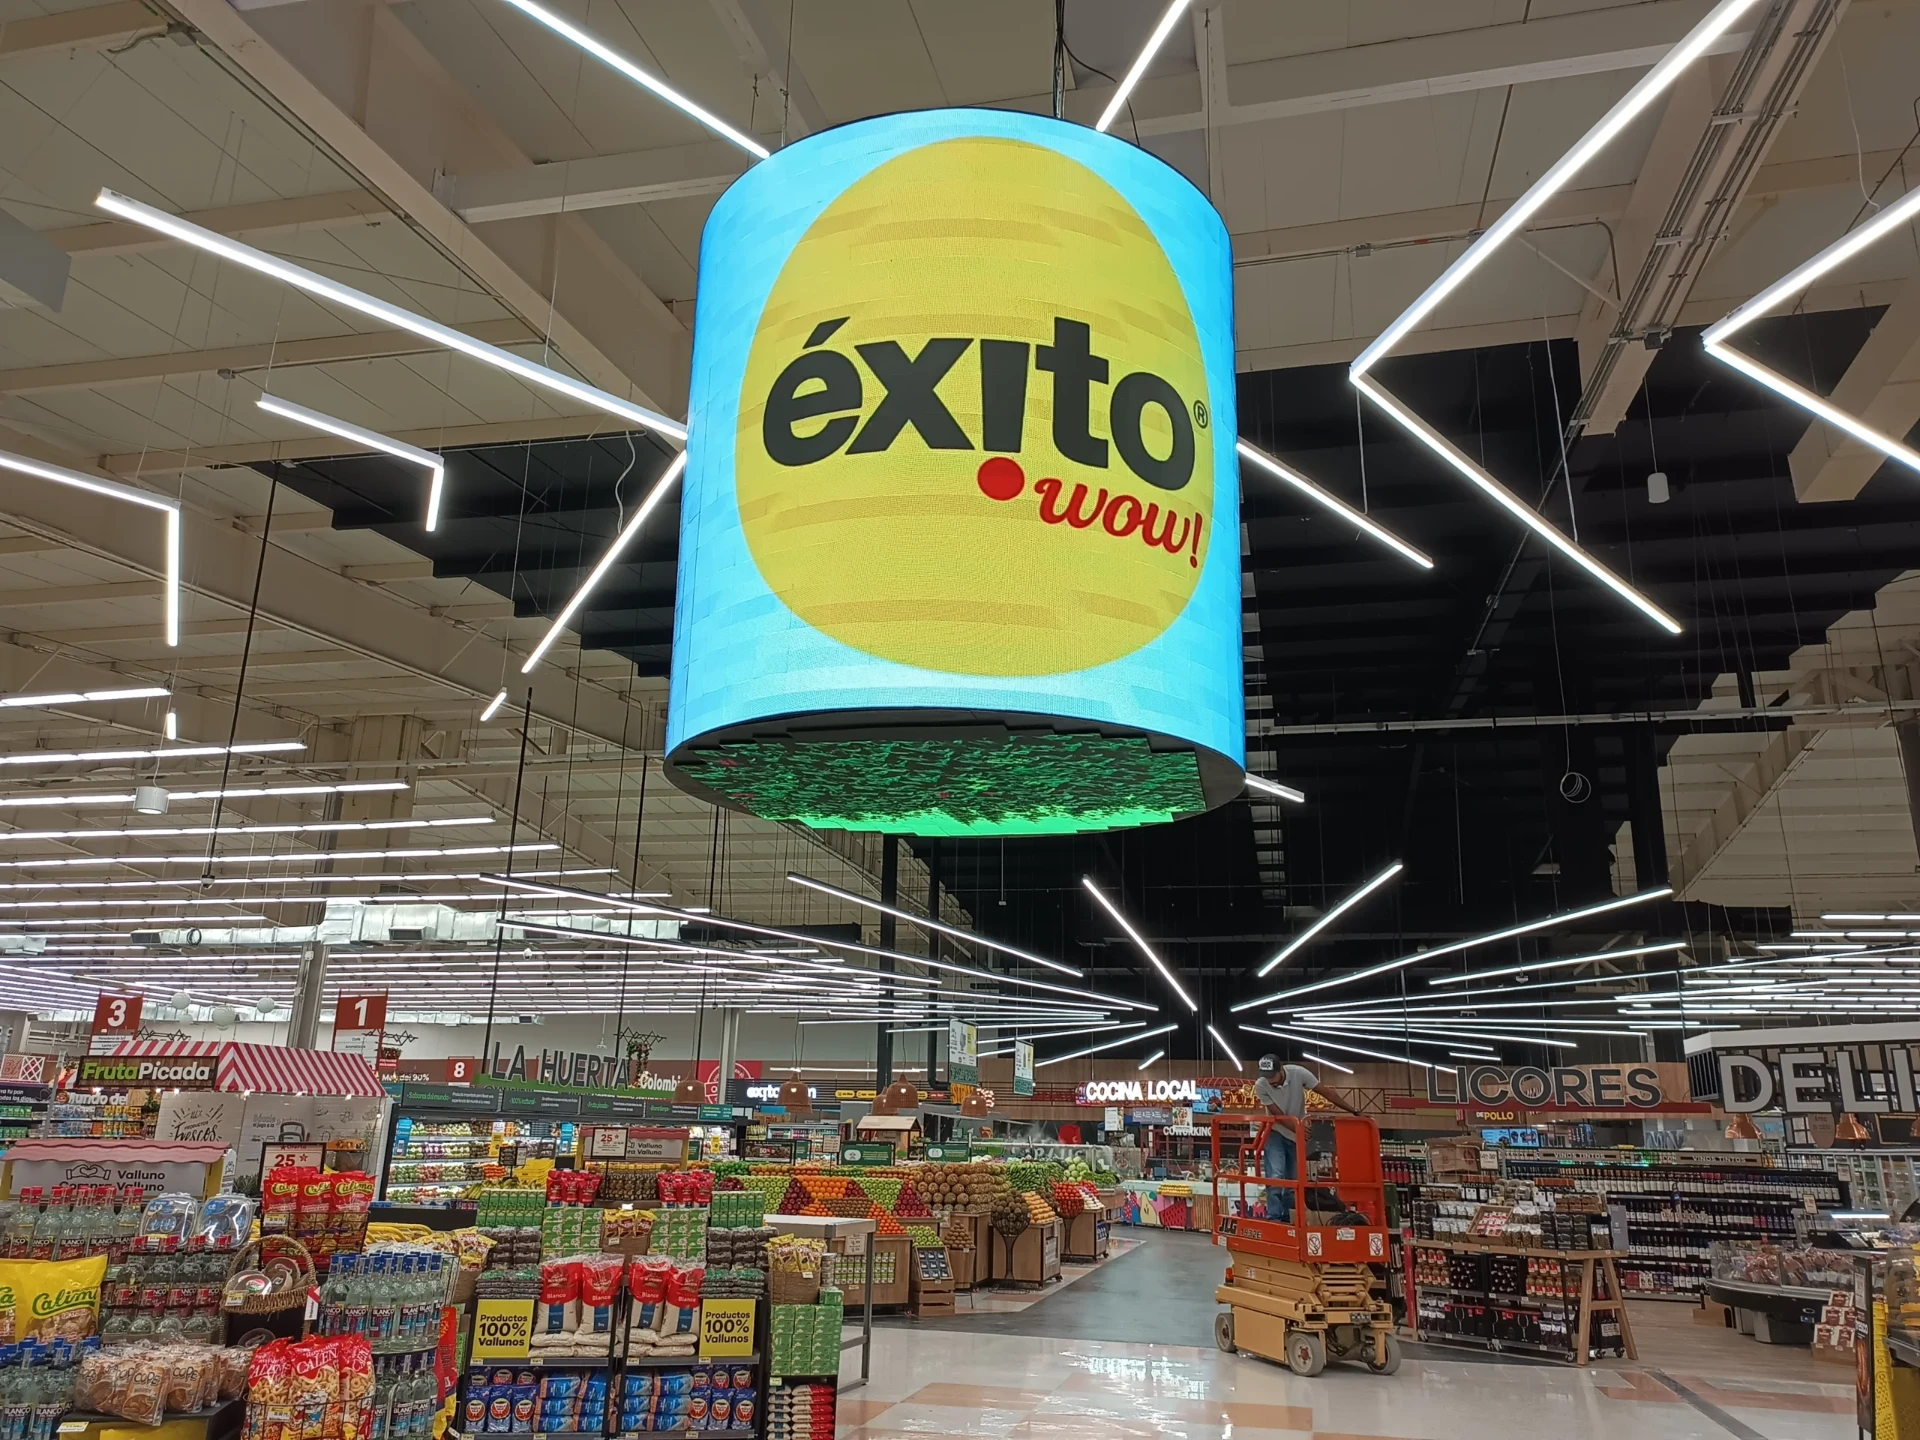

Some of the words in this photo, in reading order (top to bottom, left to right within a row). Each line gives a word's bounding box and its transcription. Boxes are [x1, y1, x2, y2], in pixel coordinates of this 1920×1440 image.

[762, 316, 1195, 500] éxito
[1033, 477, 1203, 568] wow!
[107, 999, 127, 1027] 3
[354, 998, 368, 1027] 1
[453, 1062, 466, 1078] 8
[490, 1041, 527, 1083] LA
[539, 1048, 631, 1091] HUERTA
[412, 1073, 429, 1081] 90%
[639, 1071, 682, 1092] Colombi
[1718, 1050, 1916, 1113] DELI
[1085, 1081, 1143, 1101] COCINA
[1147, 1080, 1202, 1101] LOCAL
[1425, 1065, 1661, 1108] LICORES
[1484, 1111, 1514, 1121] POLLO
[601, 1134, 613, 1142] 25
[274, 1153, 296, 1168] 25
[117, 1170, 166, 1180] Valluno
[116, 1182, 165, 1191] Valluno
[1218, 1217, 1239, 1235] JLG
[1240, 1228, 1262, 1239] 1932E
[641, 1291, 660, 1299] Blanco
[678, 1295, 698, 1303] Blanco
[345, 1307, 367, 1315] BLANCO
[372, 1307, 395, 1315] BLANCO
[479, 1314, 528, 1322] Productos
[705, 1311, 751, 1319] Productos
[478, 1322, 527, 1337] 100%
[704, 1319, 750, 1334] 100%
[478, 1337, 525, 1347] Vallunos
[704, 1334, 749, 1344] Vallunos
[133, 1371, 161, 1387] COPE
[172, 1366, 200, 1382] COPE
[4, 1406, 31, 1415] BLANCO
[36, 1407, 63, 1415] BLANCO
